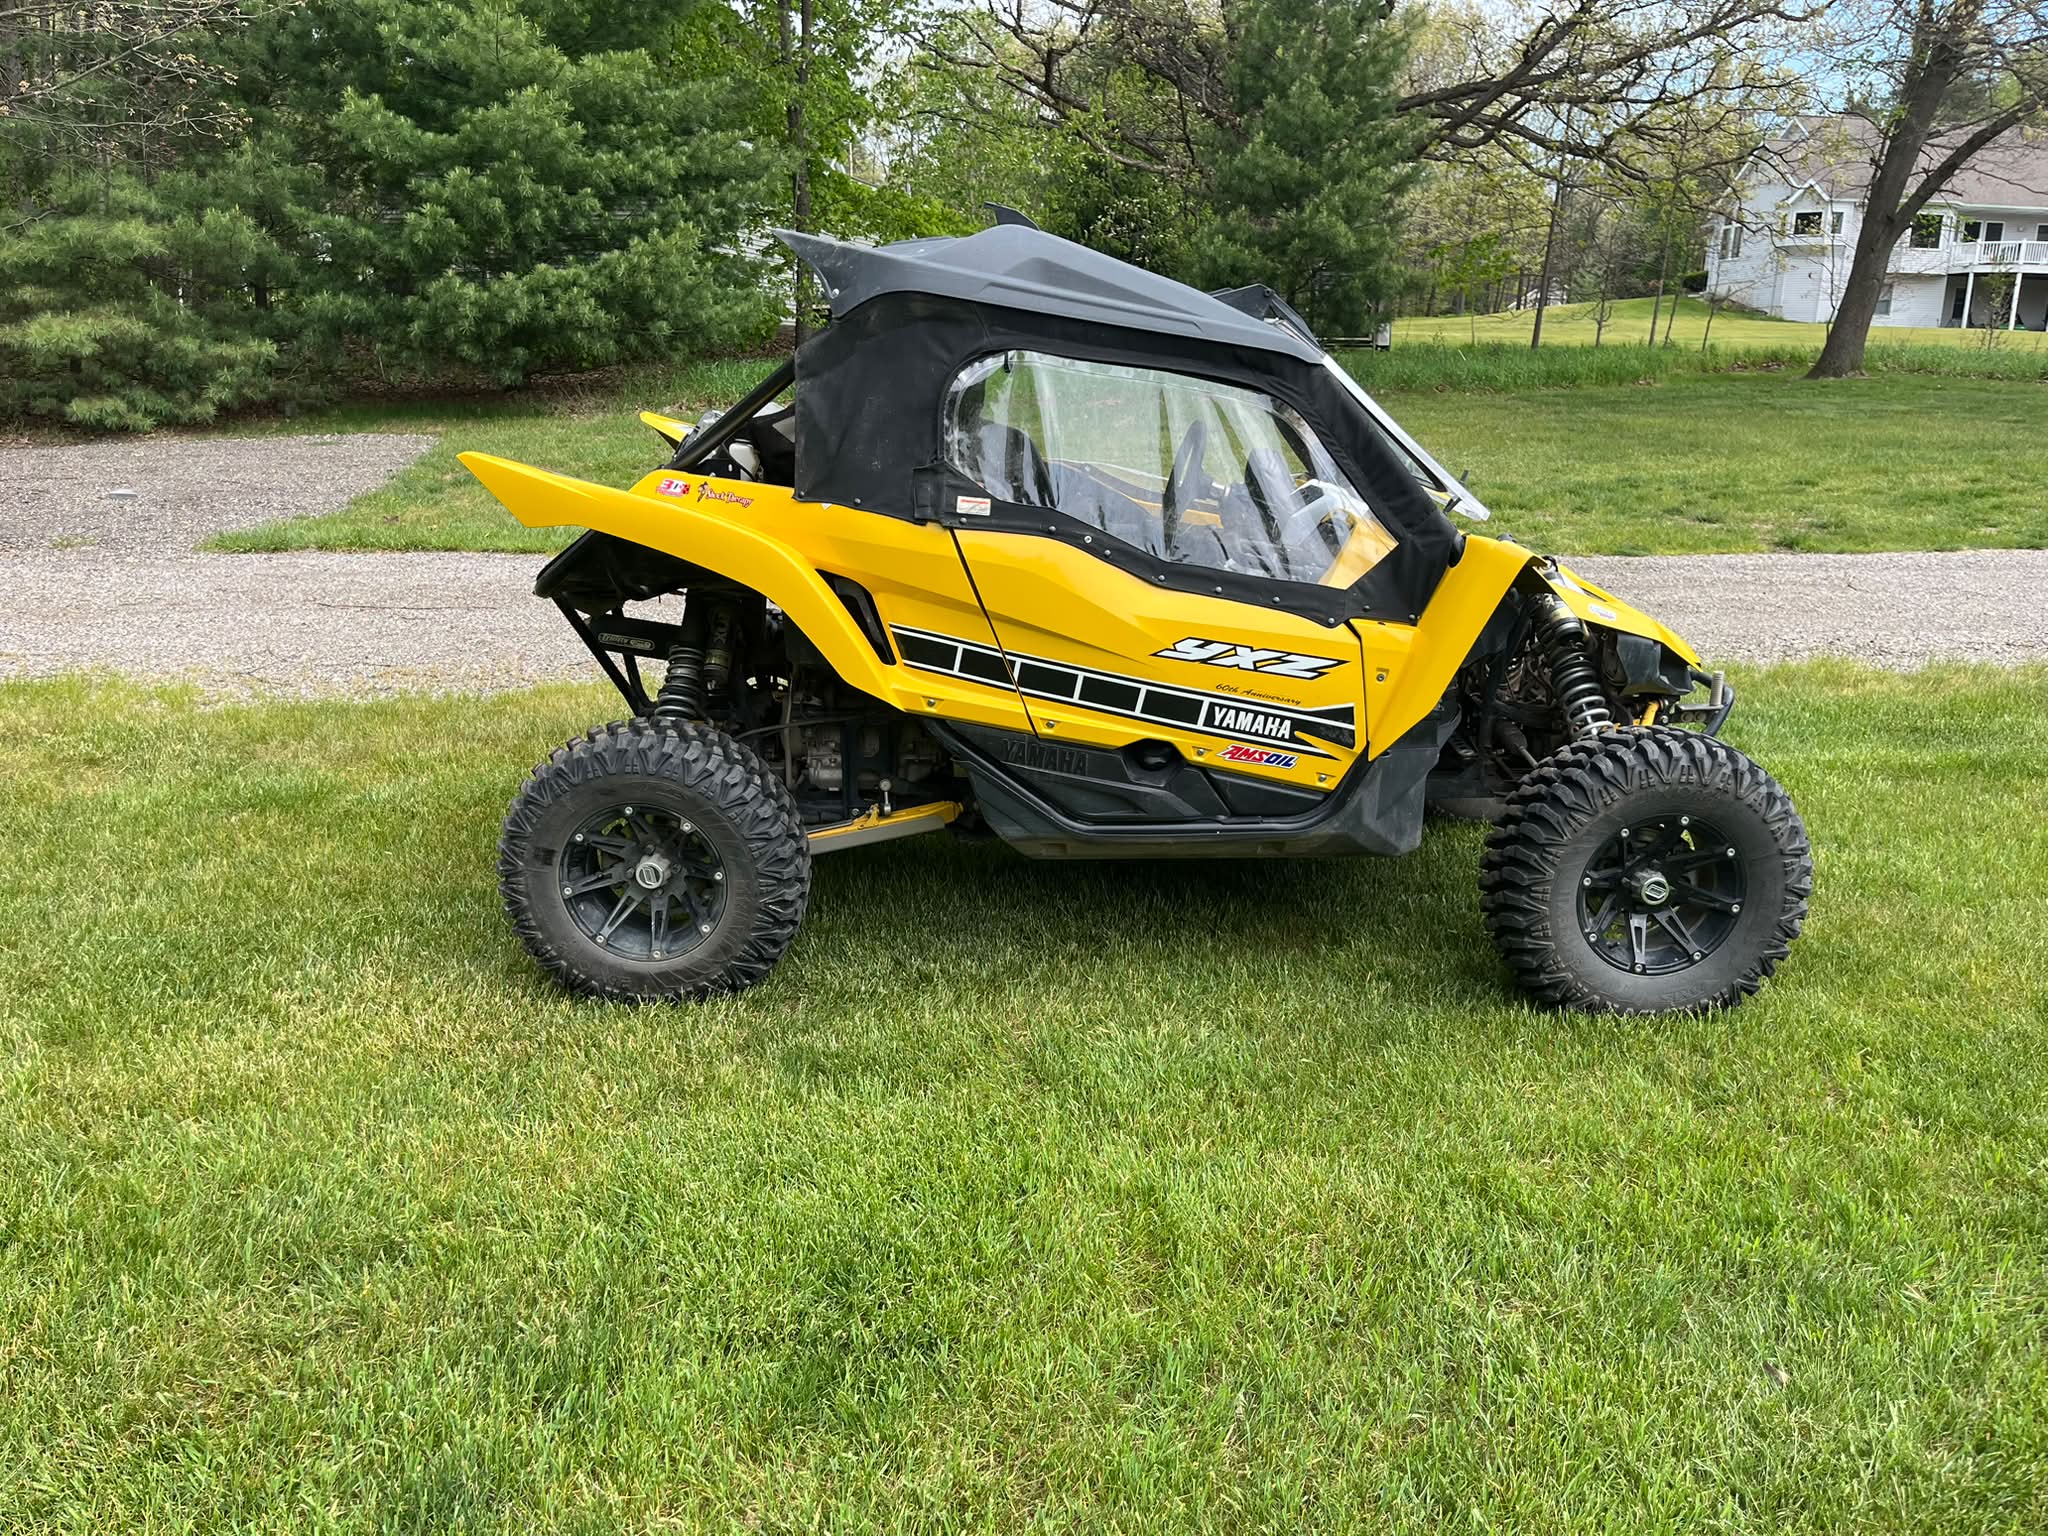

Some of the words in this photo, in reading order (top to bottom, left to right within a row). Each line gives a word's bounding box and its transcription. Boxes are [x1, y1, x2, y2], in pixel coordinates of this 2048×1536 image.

[1150, 637, 1350, 680] YXZ
[1215, 683, 1238, 694] 60th
[1243, 687, 1302, 706] Anniversary
[1213, 705, 1293, 740] YAMAHA
[1001, 738, 1089, 777] YAMAHA
[1220, 744, 1300, 769] AMSOIL
